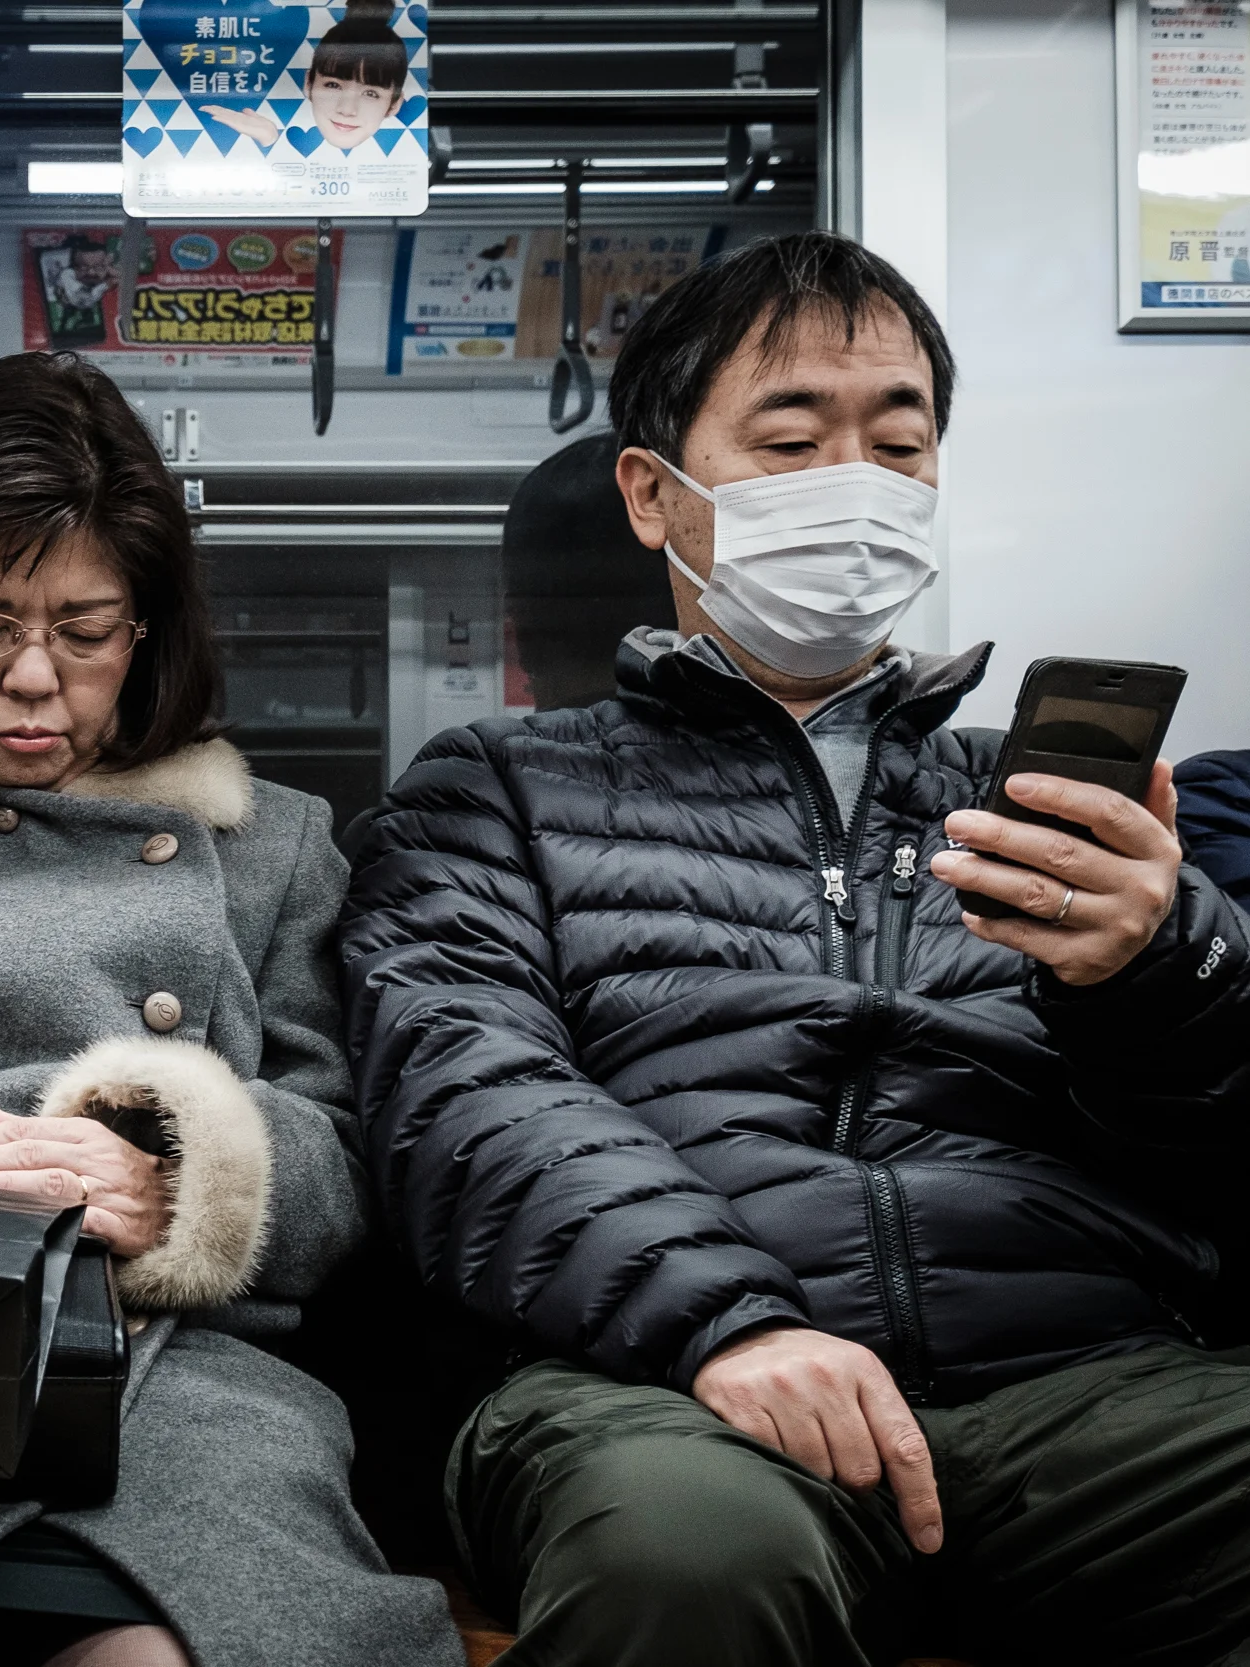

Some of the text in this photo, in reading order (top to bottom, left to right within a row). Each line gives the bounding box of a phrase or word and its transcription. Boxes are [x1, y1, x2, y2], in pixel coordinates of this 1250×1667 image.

[195, 16, 261, 39] 素肌に
[179, 43, 275, 66] チョコっと
[310, 181, 350, 196] ¥300
[1168, 241, 1190, 262] 原
[1198, 241, 1220, 262] 晋
[1197, 936, 1227, 979] 850
